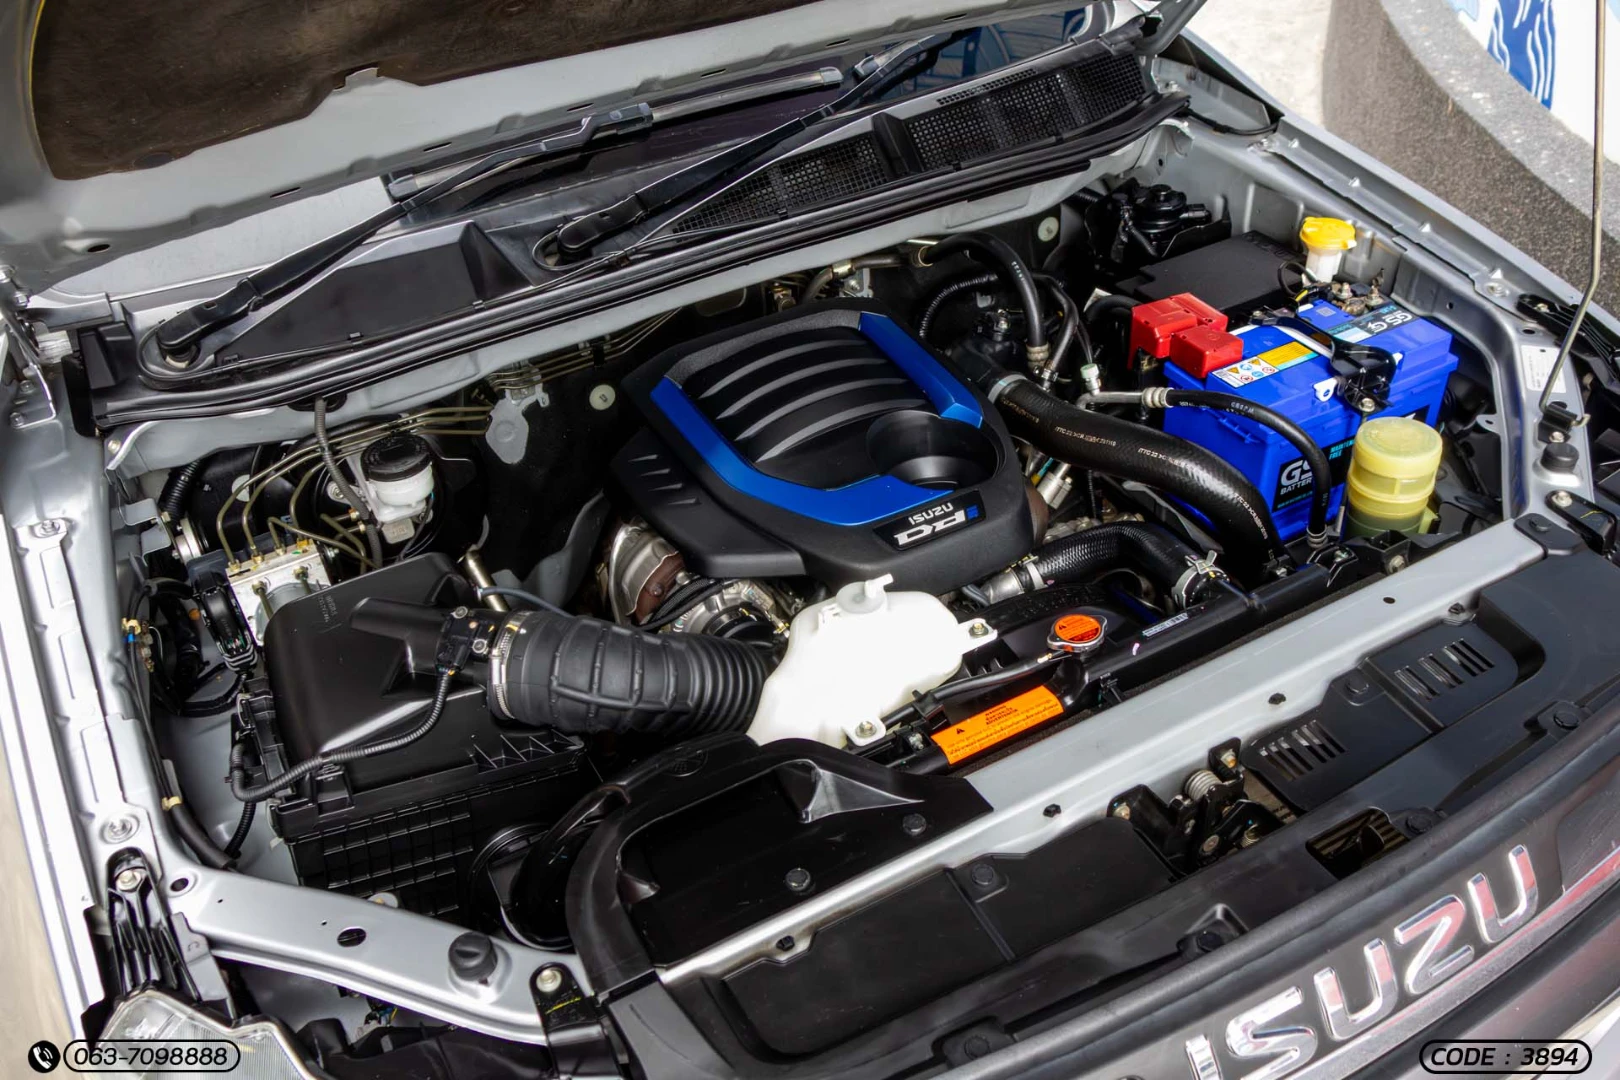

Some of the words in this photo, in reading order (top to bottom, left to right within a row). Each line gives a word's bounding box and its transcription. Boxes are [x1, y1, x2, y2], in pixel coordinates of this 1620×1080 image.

[1280, 477, 1313, 495] BATTER
[908, 502, 954, 526] ISUZU
[1184, 843, 1539, 1080] ISUZU
